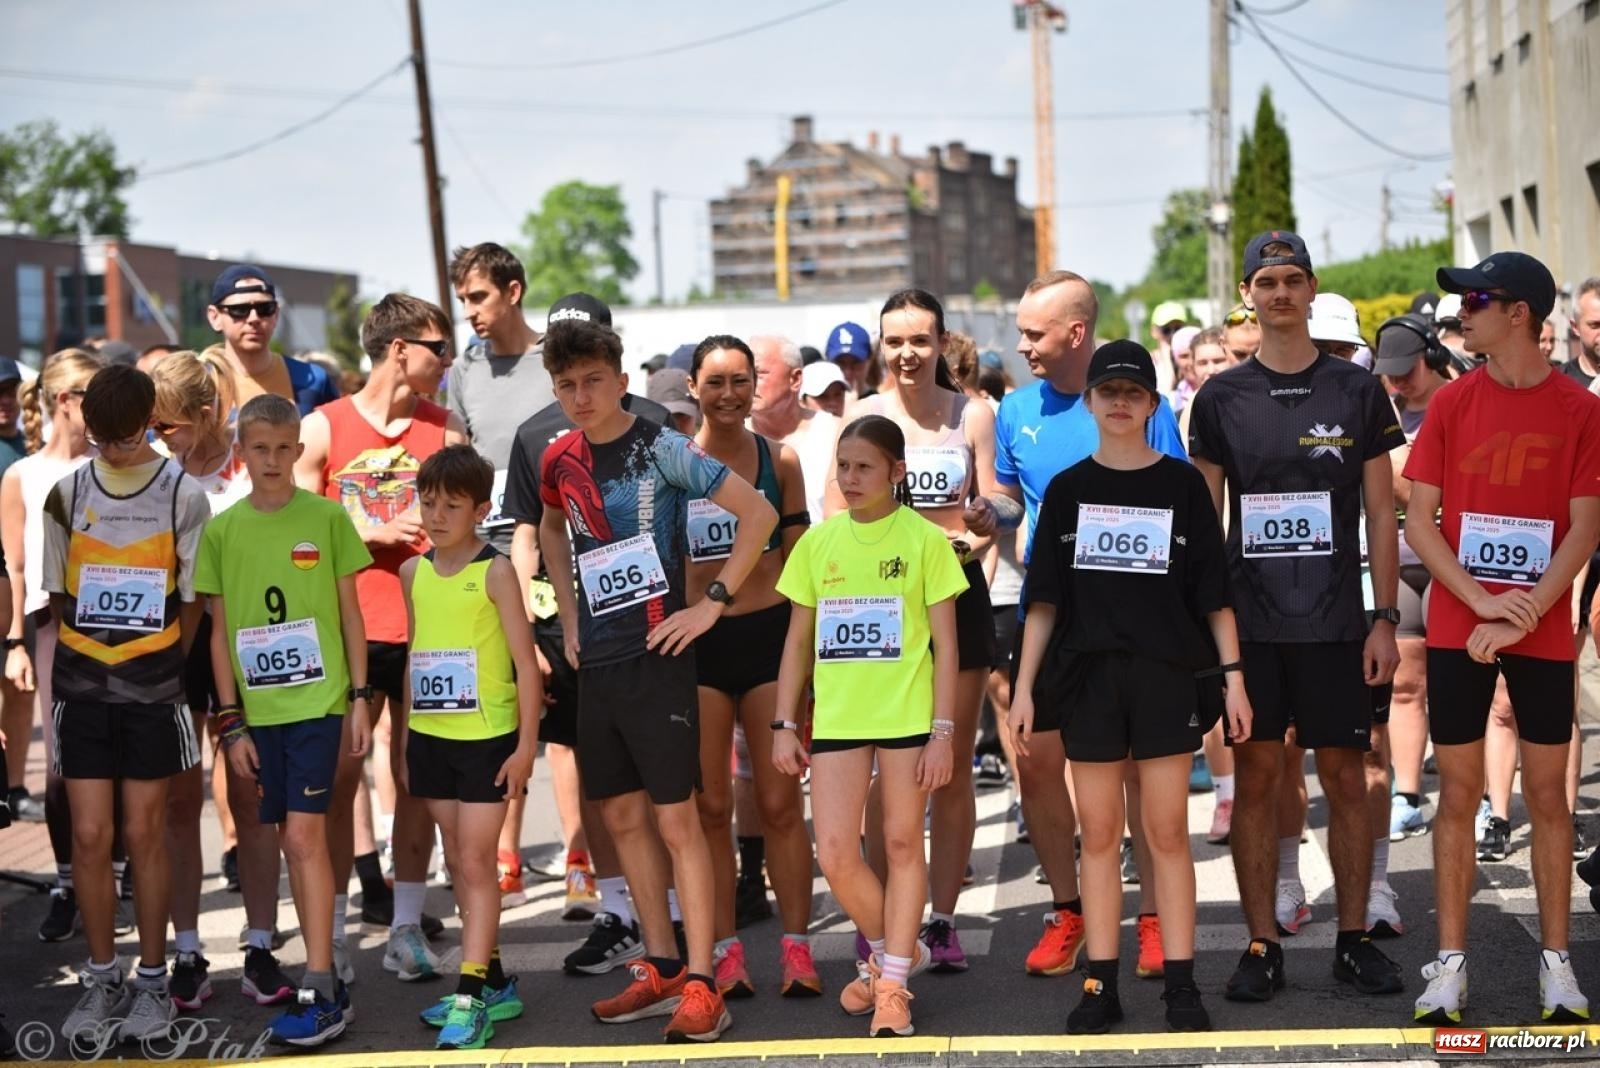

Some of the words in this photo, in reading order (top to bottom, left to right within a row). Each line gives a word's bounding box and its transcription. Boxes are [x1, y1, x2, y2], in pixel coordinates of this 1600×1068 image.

[549, 307, 591, 323] adidas
[1458, 431, 1564, 487] 4F
[906, 471, 948, 491] 008
[1296, 493, 1324, 501] GRANIC
[1101, 506, 1120, 514] BIEG
[1121, 508, 1136, 516] BEZ
[1136, 509, 1166, 518] GRANIC
[1483, 517, 1500, 525] BIEG
[1501, 518, 1516, 526] BEZ
[1516, 520, 1547, 529] GRANIC
[708, 520, 740, 542] 01
[1264, 518, 1311, 540] 038
[605, 545, 618, 554] BEZ
[619, 535, 647, 549] GRANIC
[1098, 531, 1149, 555] 066
[1479, 542, 1528, 567] 039
[101, 567, 117, 576] BIEG
[118, 568, 132, 577] BEZ
[133, 569, 161, 578] GRANIC
[599, 564, 643, 595] 056
[98, 591, 145, 613] 057
[265, 586, 287, 625] 9
[838, 598, 853, 606] BIEG
[869, 597, 897, 605] GRANIC
[267, 626, 280, 634] BEZ
[282, 620, 309, 631] GRANIC
[836, 623, 882, 645] 055
[257, 648, 301, 672] 065
[443, 650, 471, 658] GRANIC
[420, 675, 454, 697] 061
